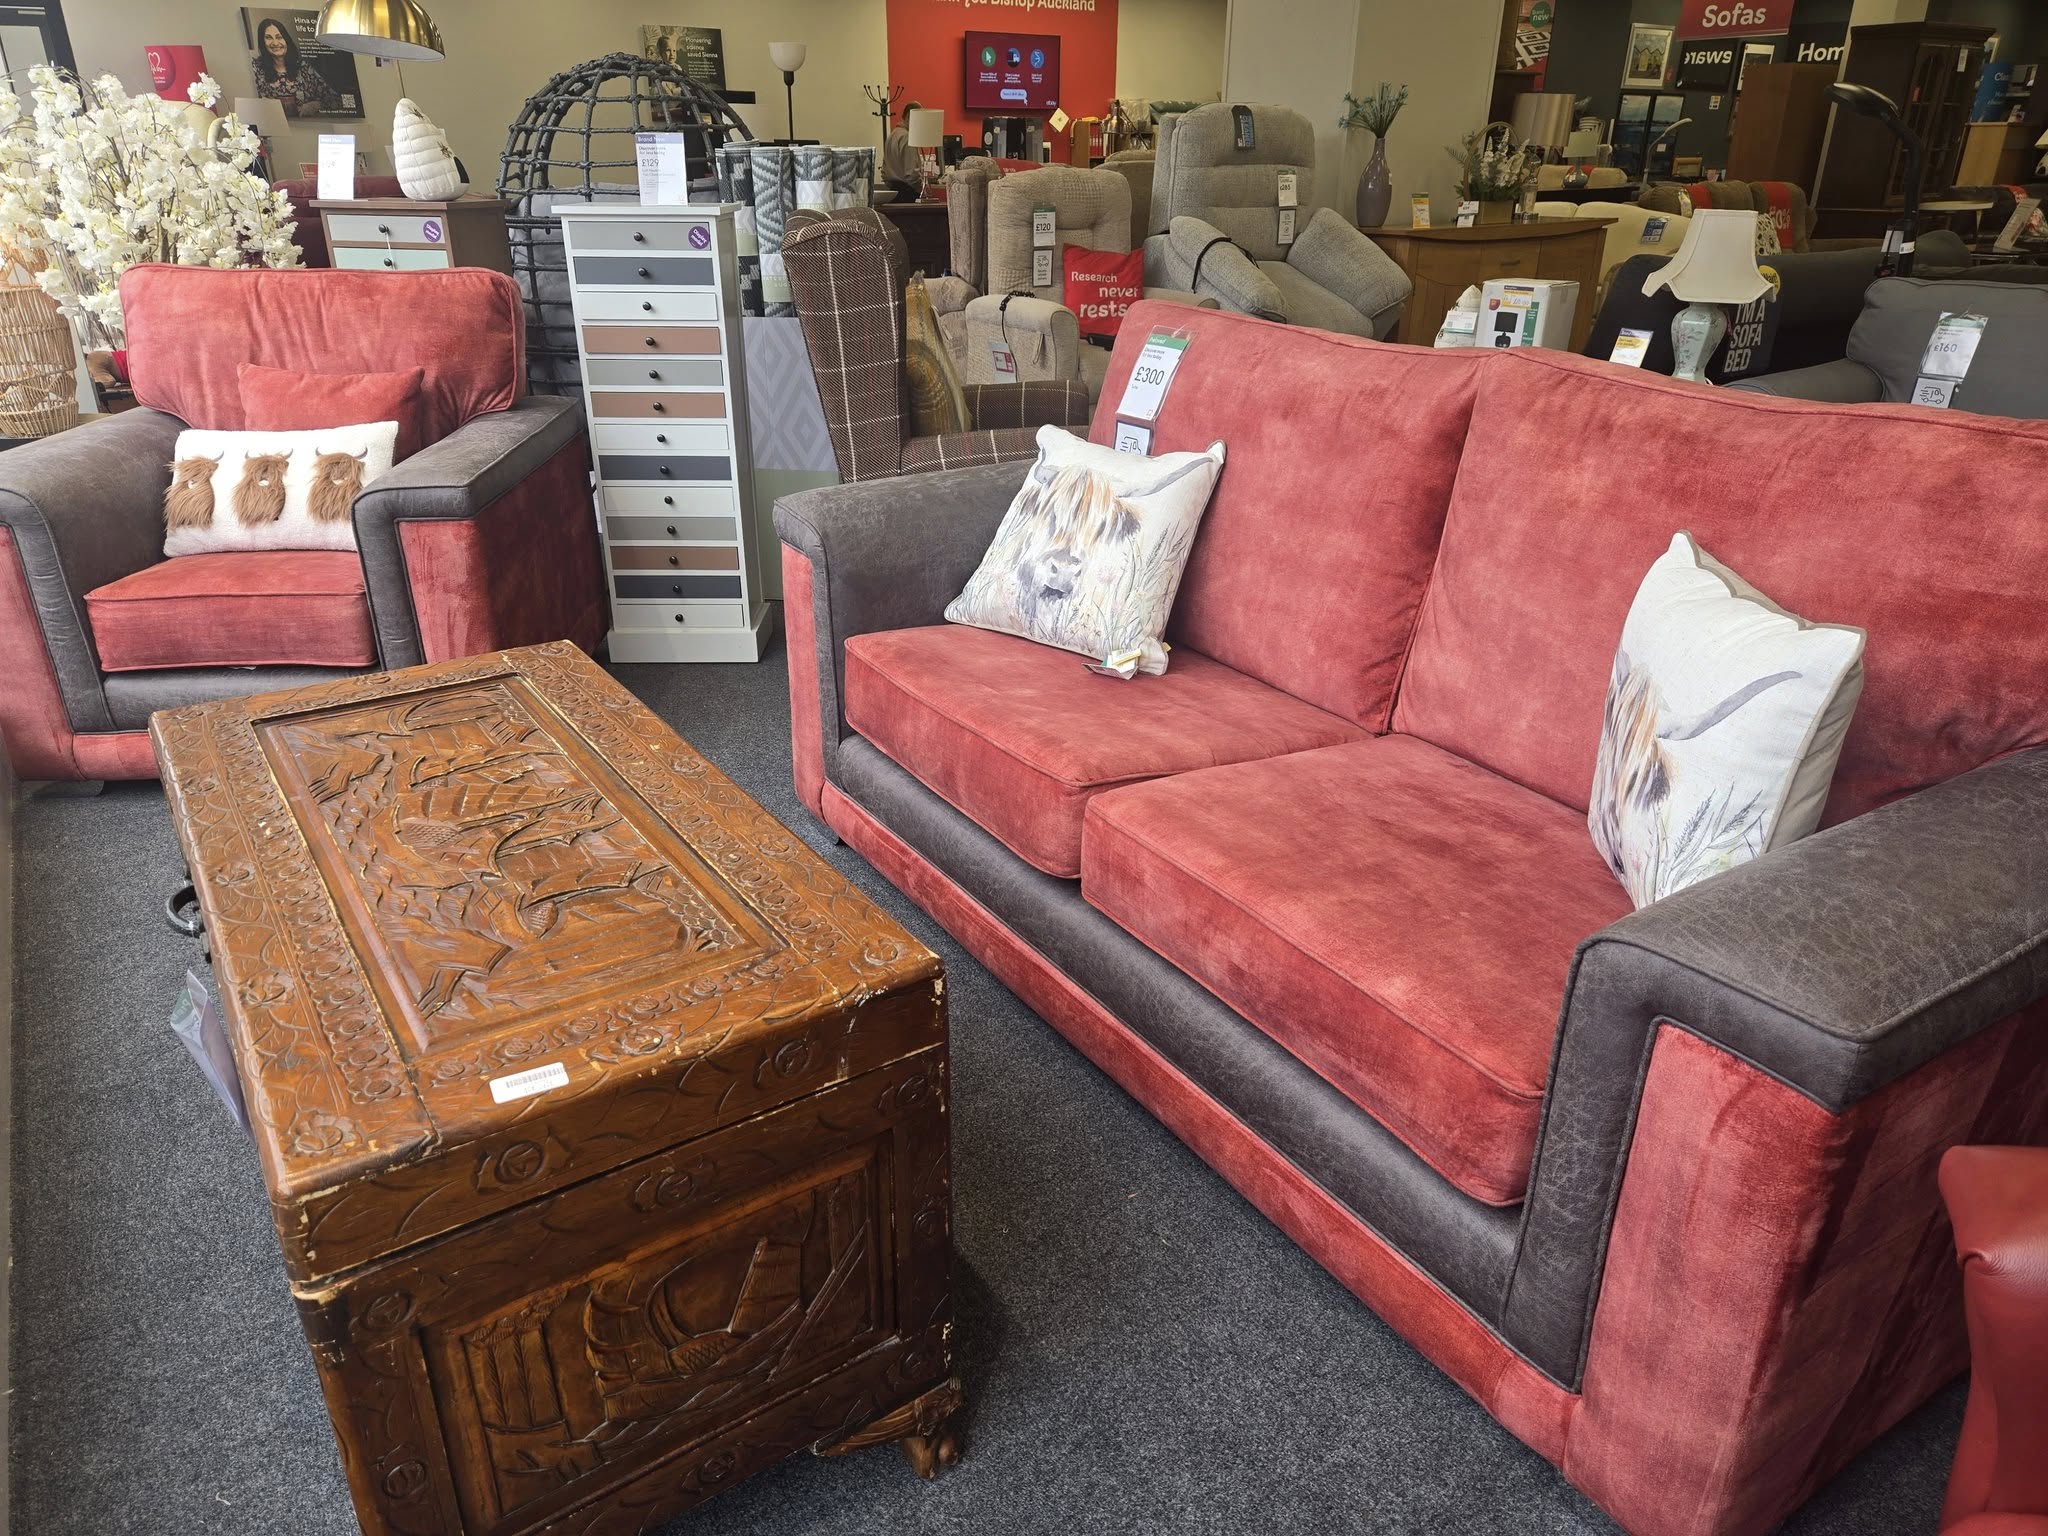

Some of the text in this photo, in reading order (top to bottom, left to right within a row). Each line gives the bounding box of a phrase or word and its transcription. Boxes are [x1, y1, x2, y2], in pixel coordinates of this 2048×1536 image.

[1037, 0, 1095, 11] Auckland
[1702, 2, 1767, 28] Sofas
[641, 158, 659, 167] £129
[1035, 222, 1051, 231] £120
[693, 228, 707, 243] Display
[1071, 271, 1117, 283] Research
[1099, 287, 1138, 298] never
[1080, 300, 1128, 318] rests
[1735, 299, 1766, 324] I'M A
[1730, 322, 1763, 349] SOFA
[1933, 342, 1958, 353] £160
[1724, 348, 1752, 373] BED
[1134, 366, 1165, 386] £300
